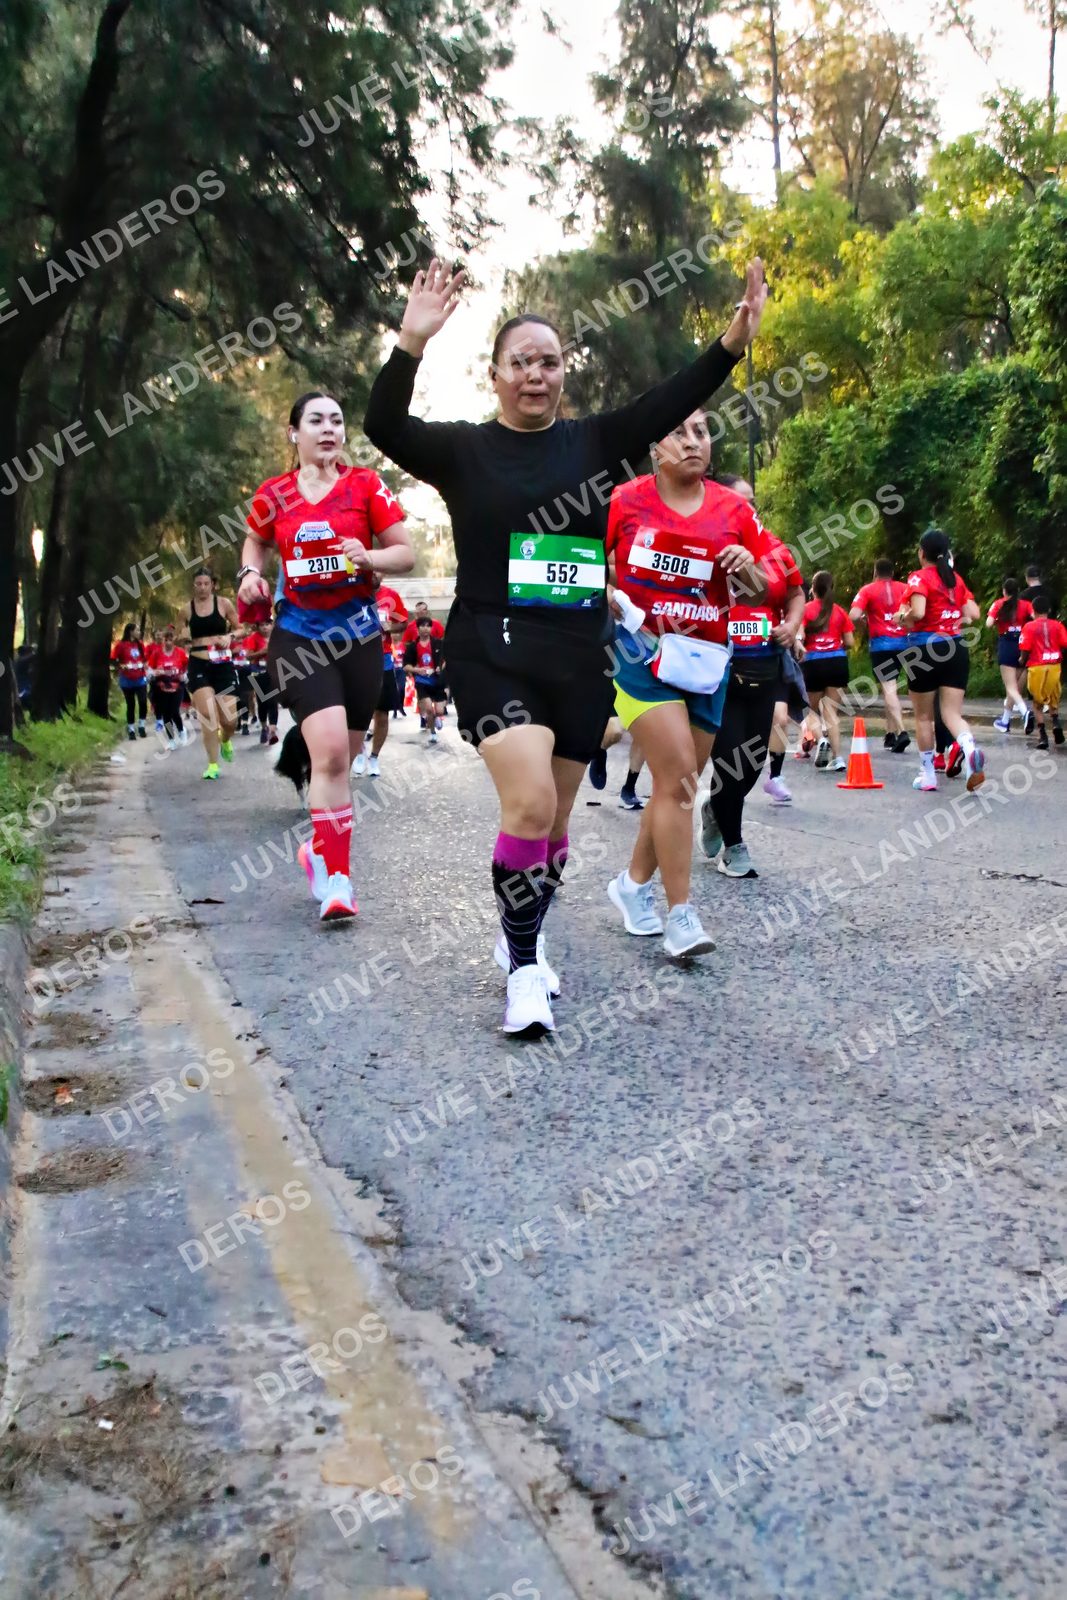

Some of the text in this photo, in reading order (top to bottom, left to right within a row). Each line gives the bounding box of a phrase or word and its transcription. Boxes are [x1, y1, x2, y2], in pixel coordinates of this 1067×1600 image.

[308, 556, 339, 573] 2370
[546, 563, 578, 584] 552
[652, 553, 690, 575] 3508
[651, 601, 719, 622] SANTIAGO
[733, 622, 758, 634] 3068
